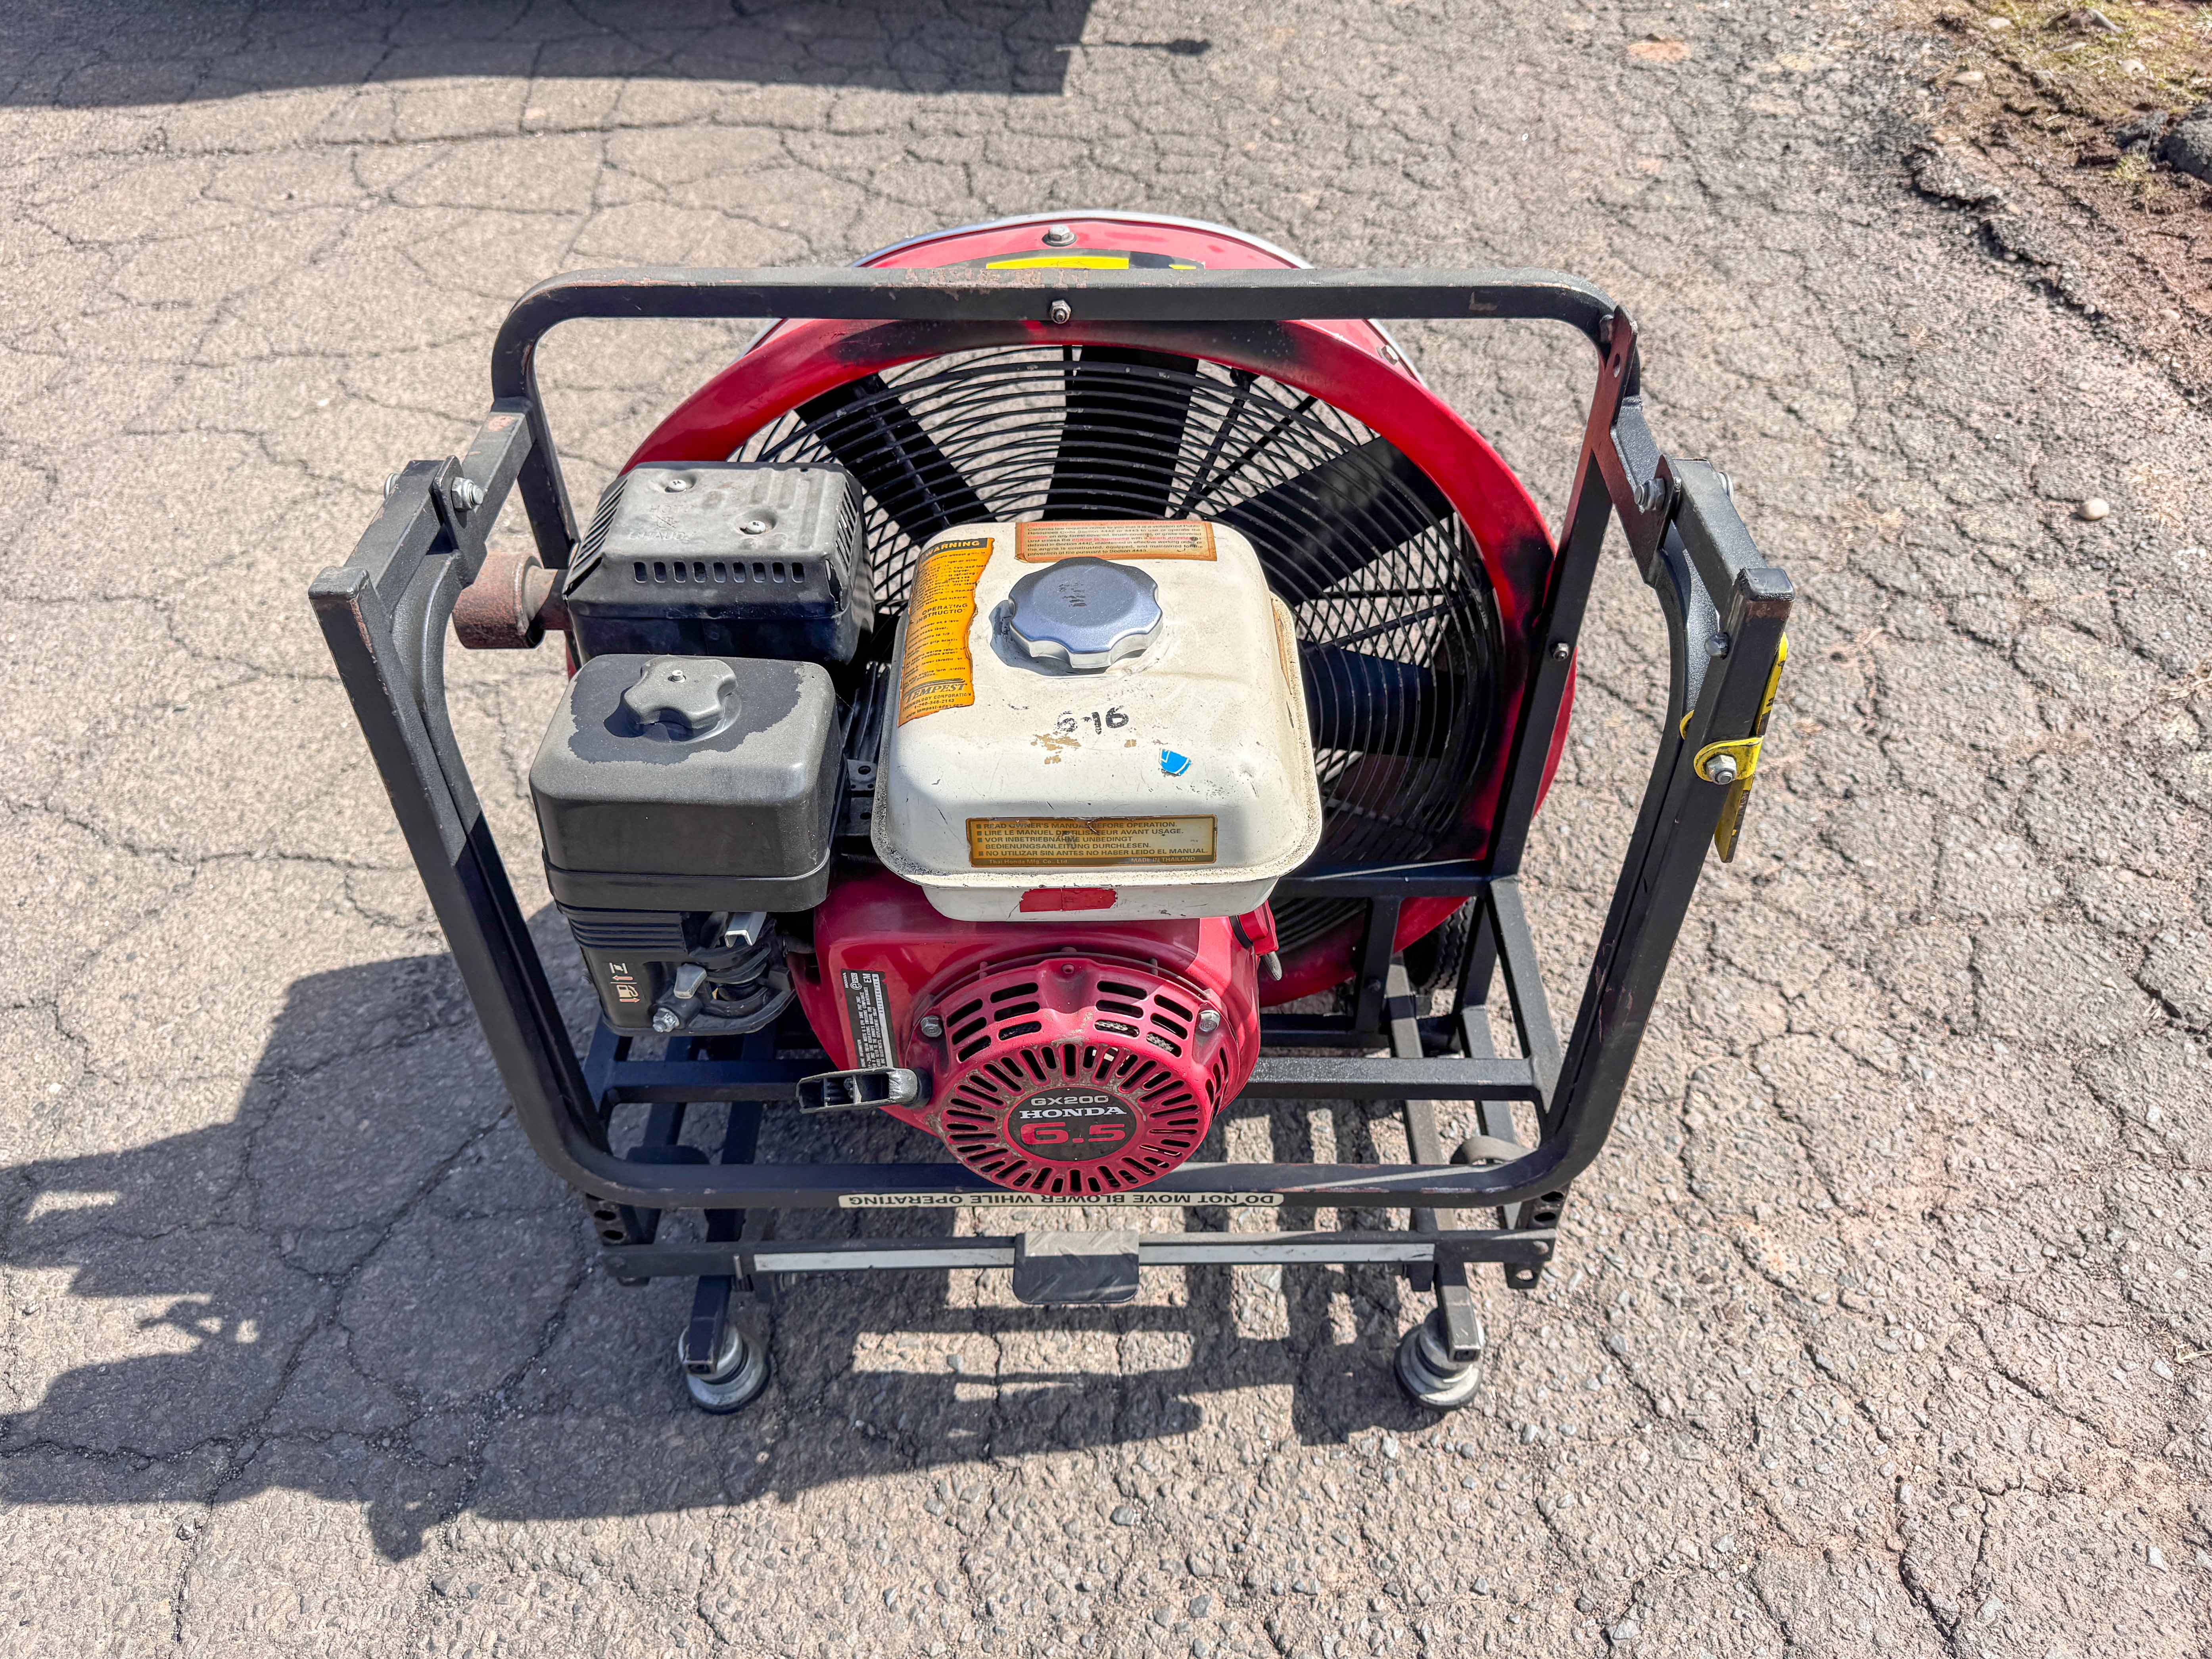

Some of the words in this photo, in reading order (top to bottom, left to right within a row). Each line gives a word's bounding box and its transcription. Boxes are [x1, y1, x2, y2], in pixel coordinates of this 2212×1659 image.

[926, 541, 980, 557] WARNING
[922, 603, 968, 615] OPERATING
[916, 608, 966, 625] INSTRUCTIO
[903, 683, 968, 704] TEMPEST
[985, 842, 1090, 851] BEDIENUNGSANLEITUNG
[862, 973, 872, 983] EM
[1030, 1095, 1109, 1106] GX200
[1019, 1107, 1127, 1119] HONDA
[1020, 1122, 1126, 1145] 6.5
[849, 1195, 963, 1206] OPERATING
[971, 1195, 1034, 1203] WHILE
[1041, 1194, 1125, 1204] BLOWER
[1133, 1194, 1191, 1203] MOVE
[1197, 1195, 1237, 1203] NOT
[1245, 1195, 1274, 1203] DO
